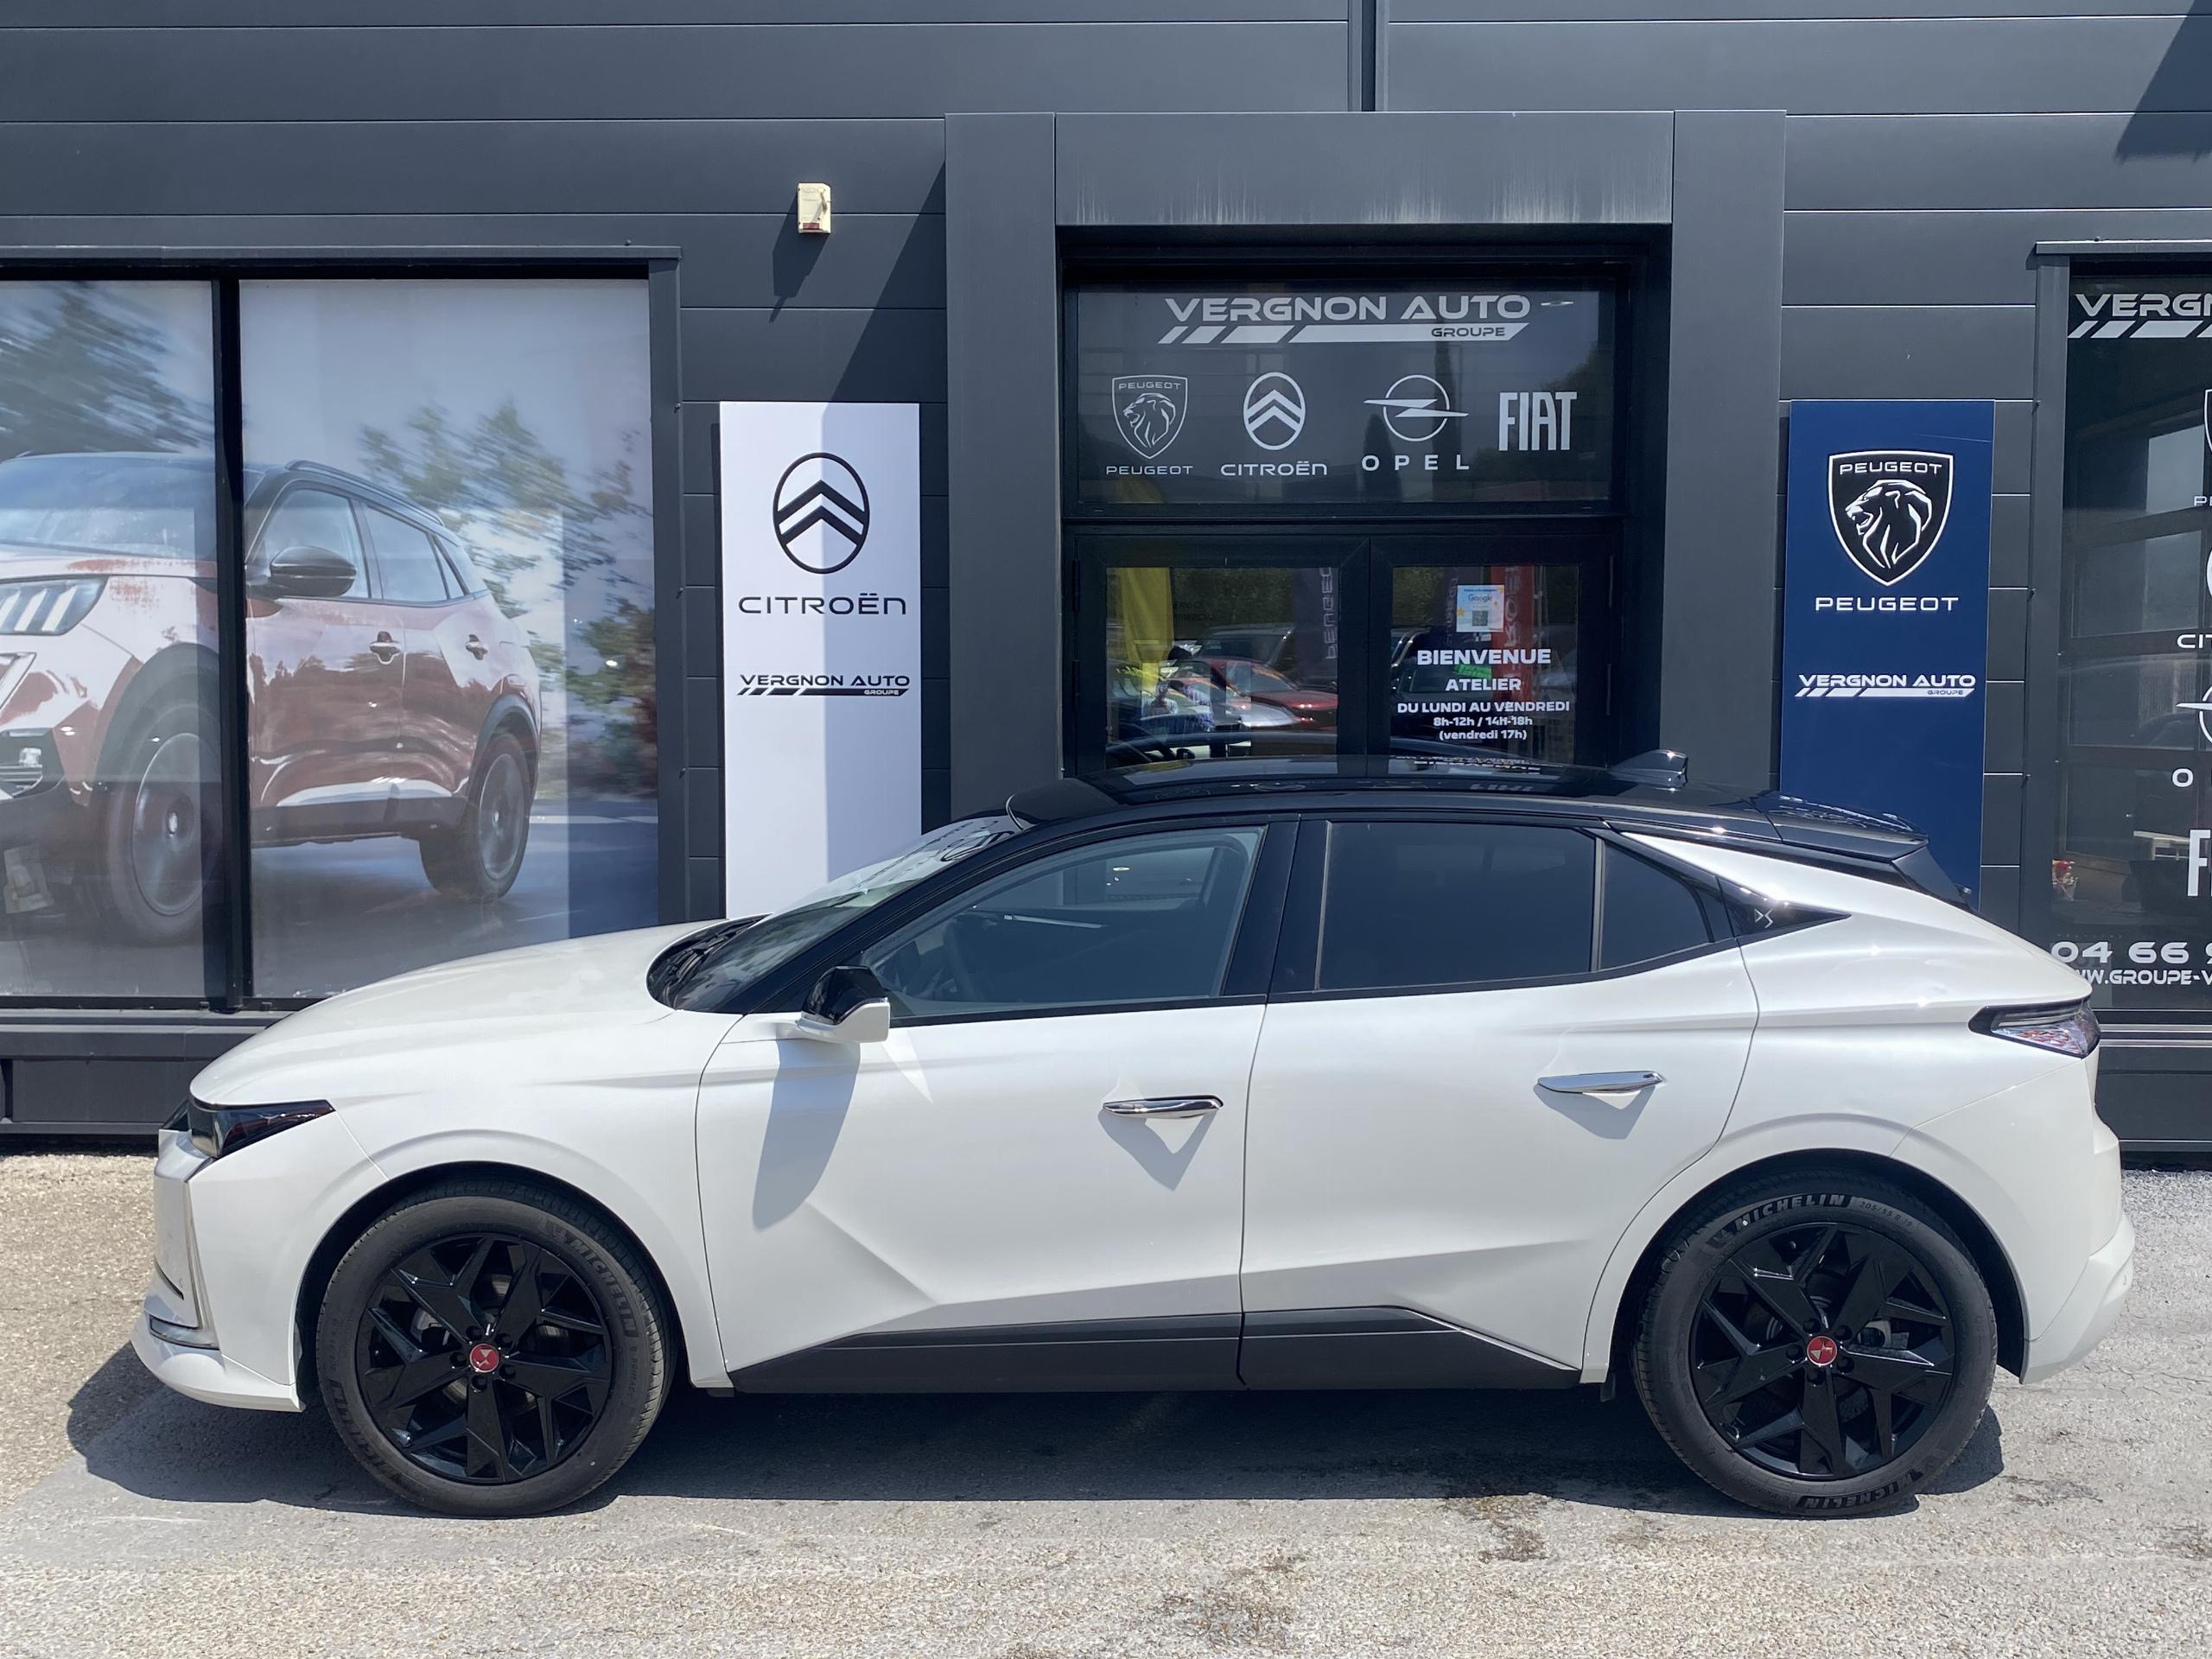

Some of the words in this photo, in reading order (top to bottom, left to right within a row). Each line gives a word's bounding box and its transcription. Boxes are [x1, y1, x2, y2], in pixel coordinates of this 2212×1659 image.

[1164, 296, 1388, 322] VERGNON
[1400, 295, 1531, 321] AUTO
[2075, 293, 2212, 317] VERG
[1431, 327, 1506, 338] GROUPE
[1118, 381, 1182, 391] PEUGEOT
[1498, 391, 1578, 451] FIAT
[1105, 465, 1194, 476] PEUGEOT
[1361, 454, 1470, 472] OPEL
[1839, 461, 1942, 476] PEUGEOT
[1815, 596, 1960, 612] PEUGEOT
[1417, 649, 1552, 665] BIENVENUE
[739, 674, 844, 686] VERGNON
[850, 675, 911, 687] AUTO
[1445, 677, 1522, 691] ATELIER
[1798, 674, 1907, 688] VERGNON
[1911, 674, 1977, 688] AUTO
[1397, 702, 1419, 714] DU
[1421, 702, 1466, 713] LUNDI
[1469, 702, 1491, 713] AU
[1494, 701, 1571, 713] VENDREDI
[1433, 716, 1475, 727] 8h-12h
[1485, 716, 1533, 727] 14h-18h
[1439, 729, 1498, 741] (vendredi
[1500, 729, 1527, 741] 17h)
[2050, 941, 2113, 963] 04
[2128, 941, 2190, 964] 66
[1735, 1194, 1846, 1231] MICHELIN
[569, 1238, 637, 1333] MICHELIN
[1805, 1471, 1915, 1508] MICHELIN
